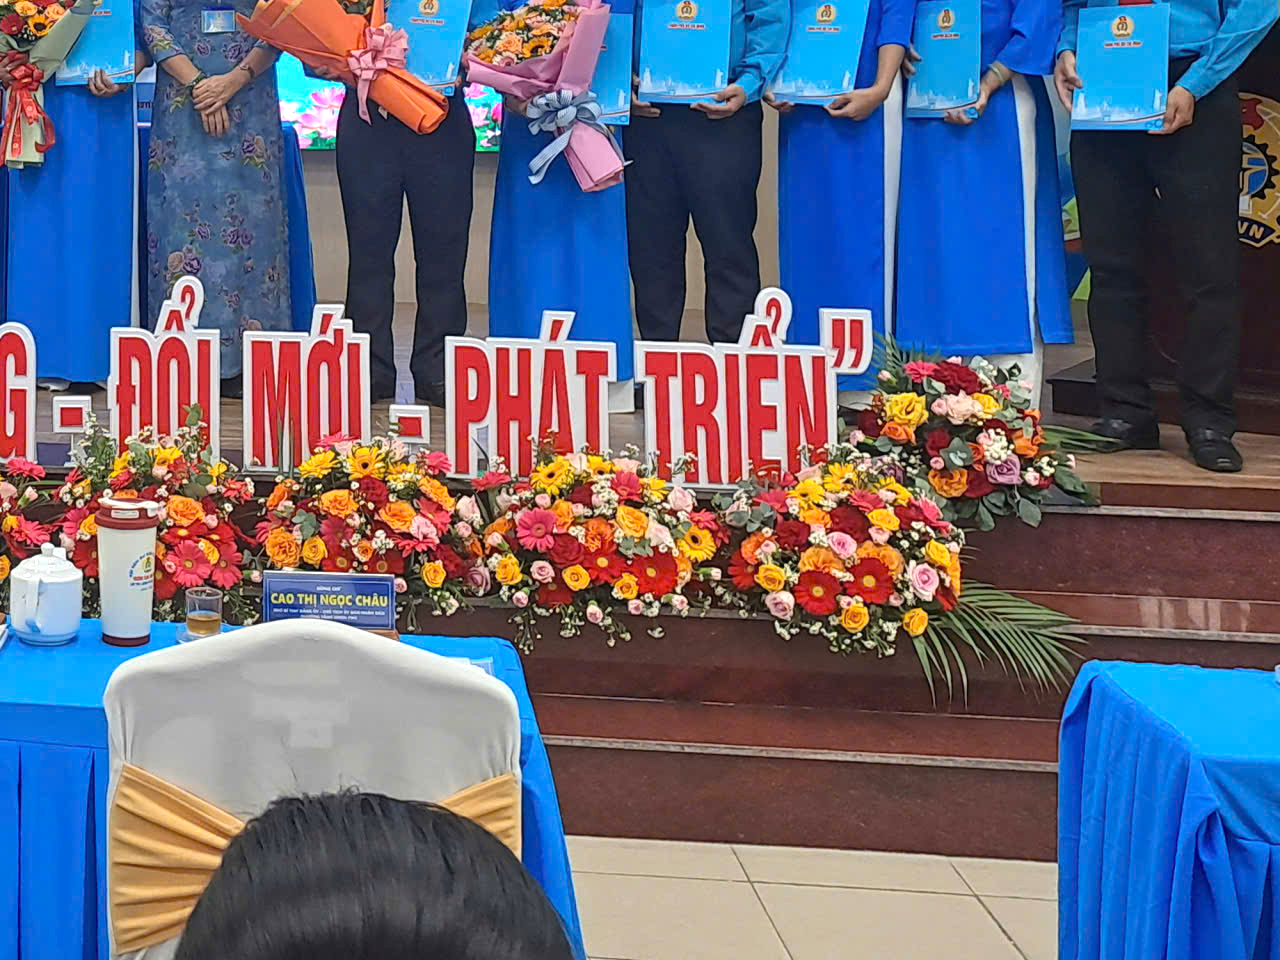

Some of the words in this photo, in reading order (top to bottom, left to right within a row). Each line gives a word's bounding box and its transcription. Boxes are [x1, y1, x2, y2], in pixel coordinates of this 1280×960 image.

[116, 284, 212, 454] ĐỔI
[251, 312, 362, 467] MỚI
[454, 319, 608, 474] PHÁT
[271, 593, 294, 604] CAO
[297, 594, 317, 608] THỊ
[320, 595, 353, 609] NGỌC
[355, 592, 388, 607] CHÂU
